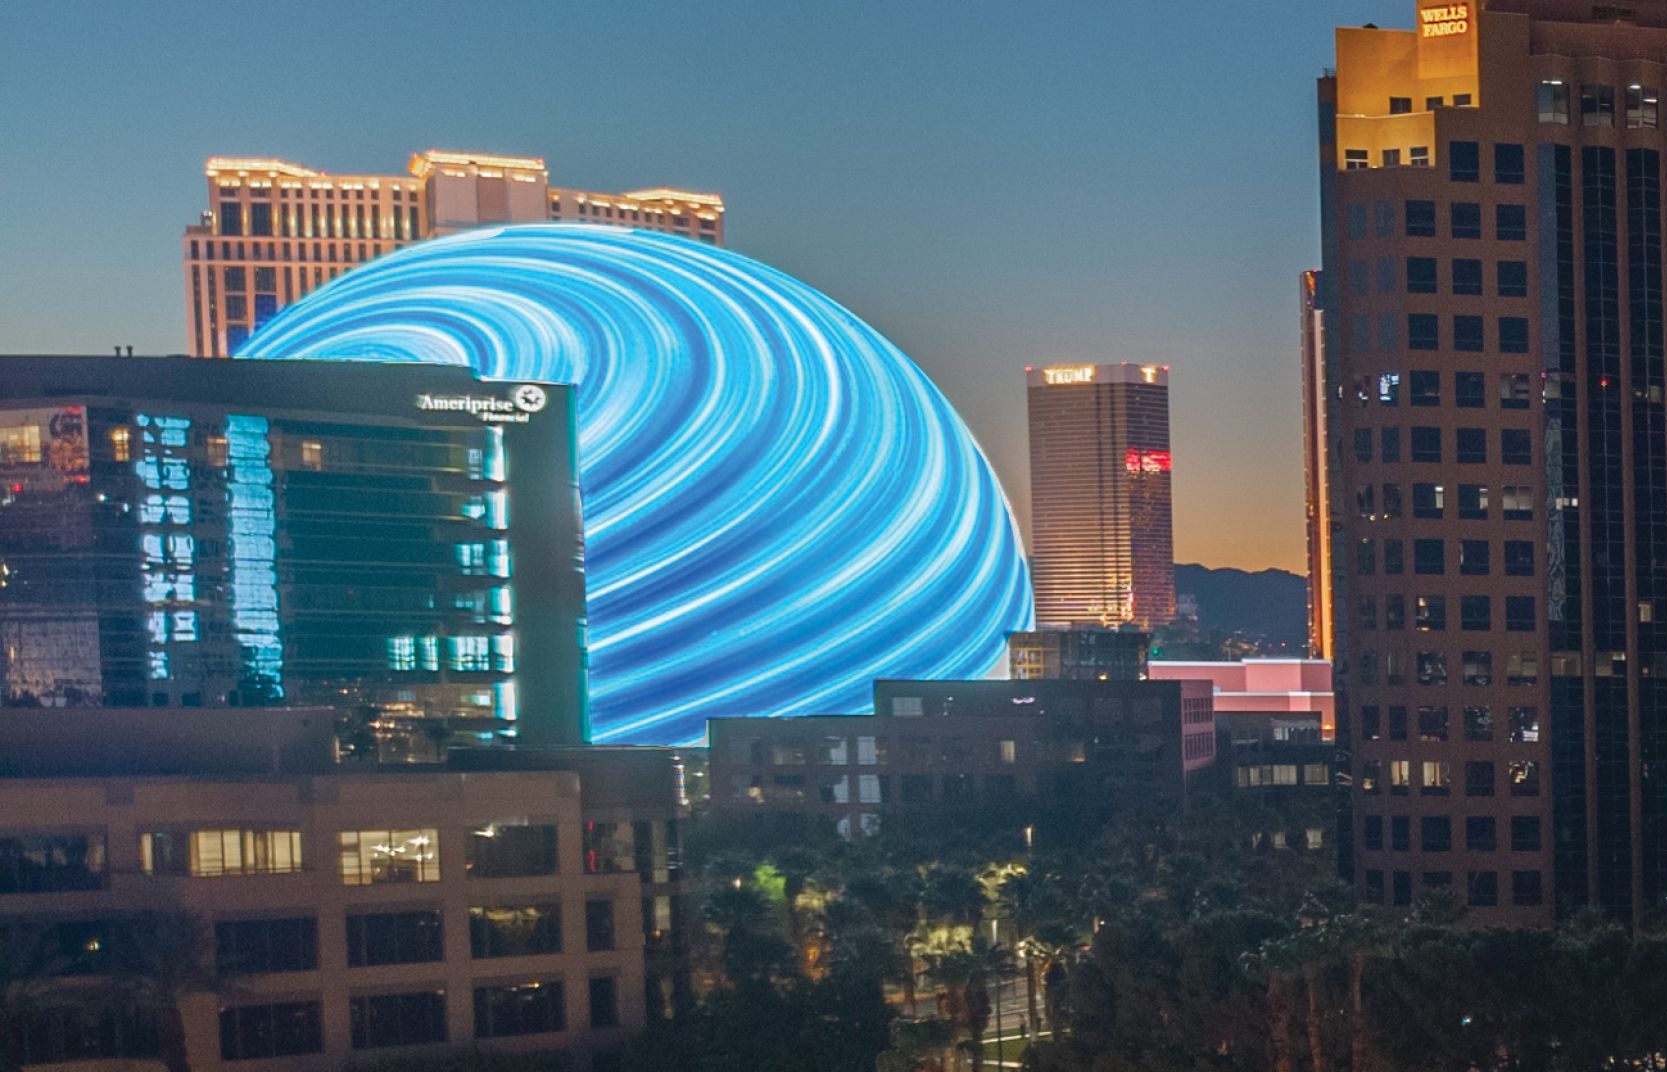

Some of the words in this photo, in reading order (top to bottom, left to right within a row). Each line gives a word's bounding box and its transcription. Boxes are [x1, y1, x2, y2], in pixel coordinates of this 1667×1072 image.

[1421, 5, 1467, 22] WELLS
[1423, 20, 1467, 37] FARGO
[418, 393, 514, 414] Ameriprise
